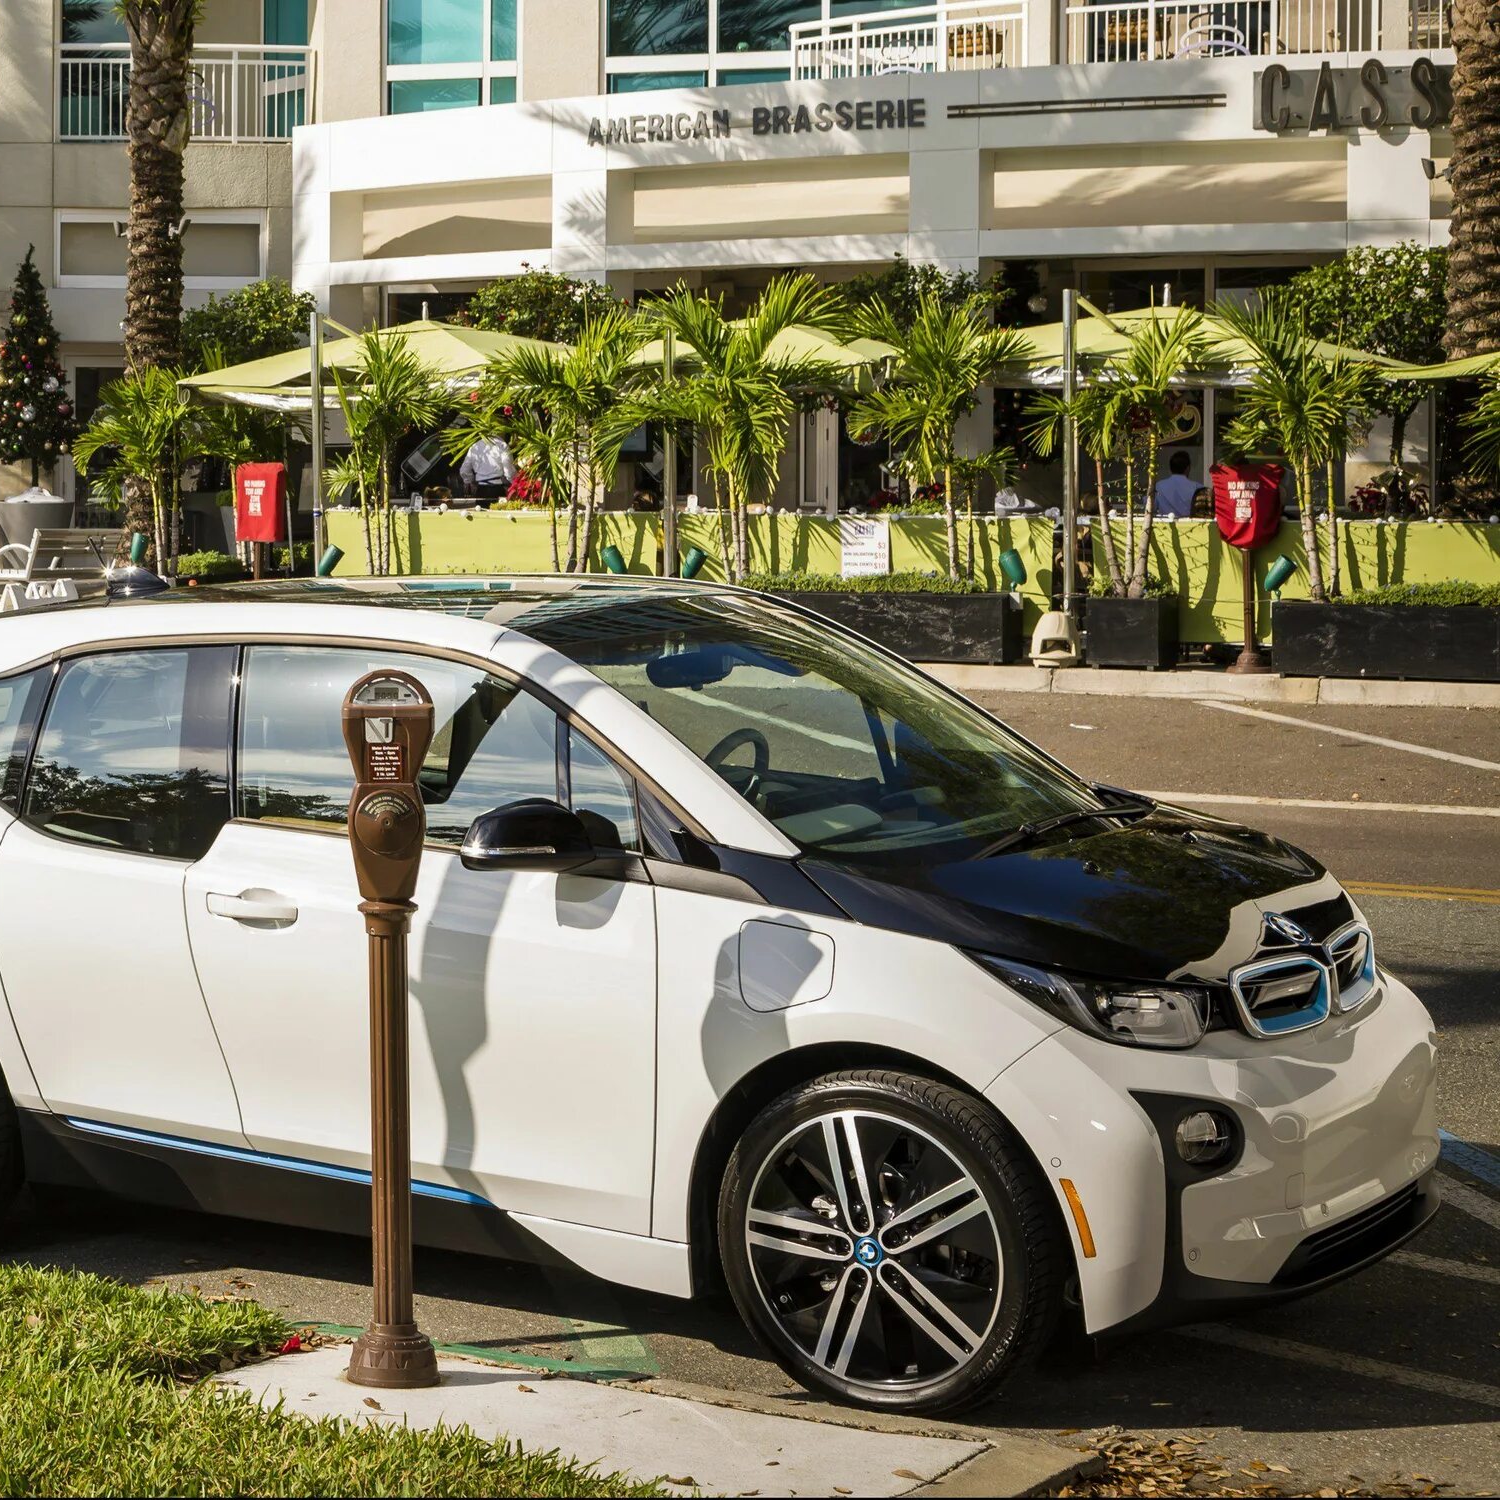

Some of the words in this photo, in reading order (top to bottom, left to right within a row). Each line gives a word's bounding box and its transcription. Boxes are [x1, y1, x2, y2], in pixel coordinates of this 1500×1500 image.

[587, 108, 731, 147] AMERICAN
[752, 98, 926, 135] BRASSERIE
[1227, 481, 1237, 490] NO
[1229, 490, 1241, 499] TOW
[1241, 490, 1257, 499] AWAY
